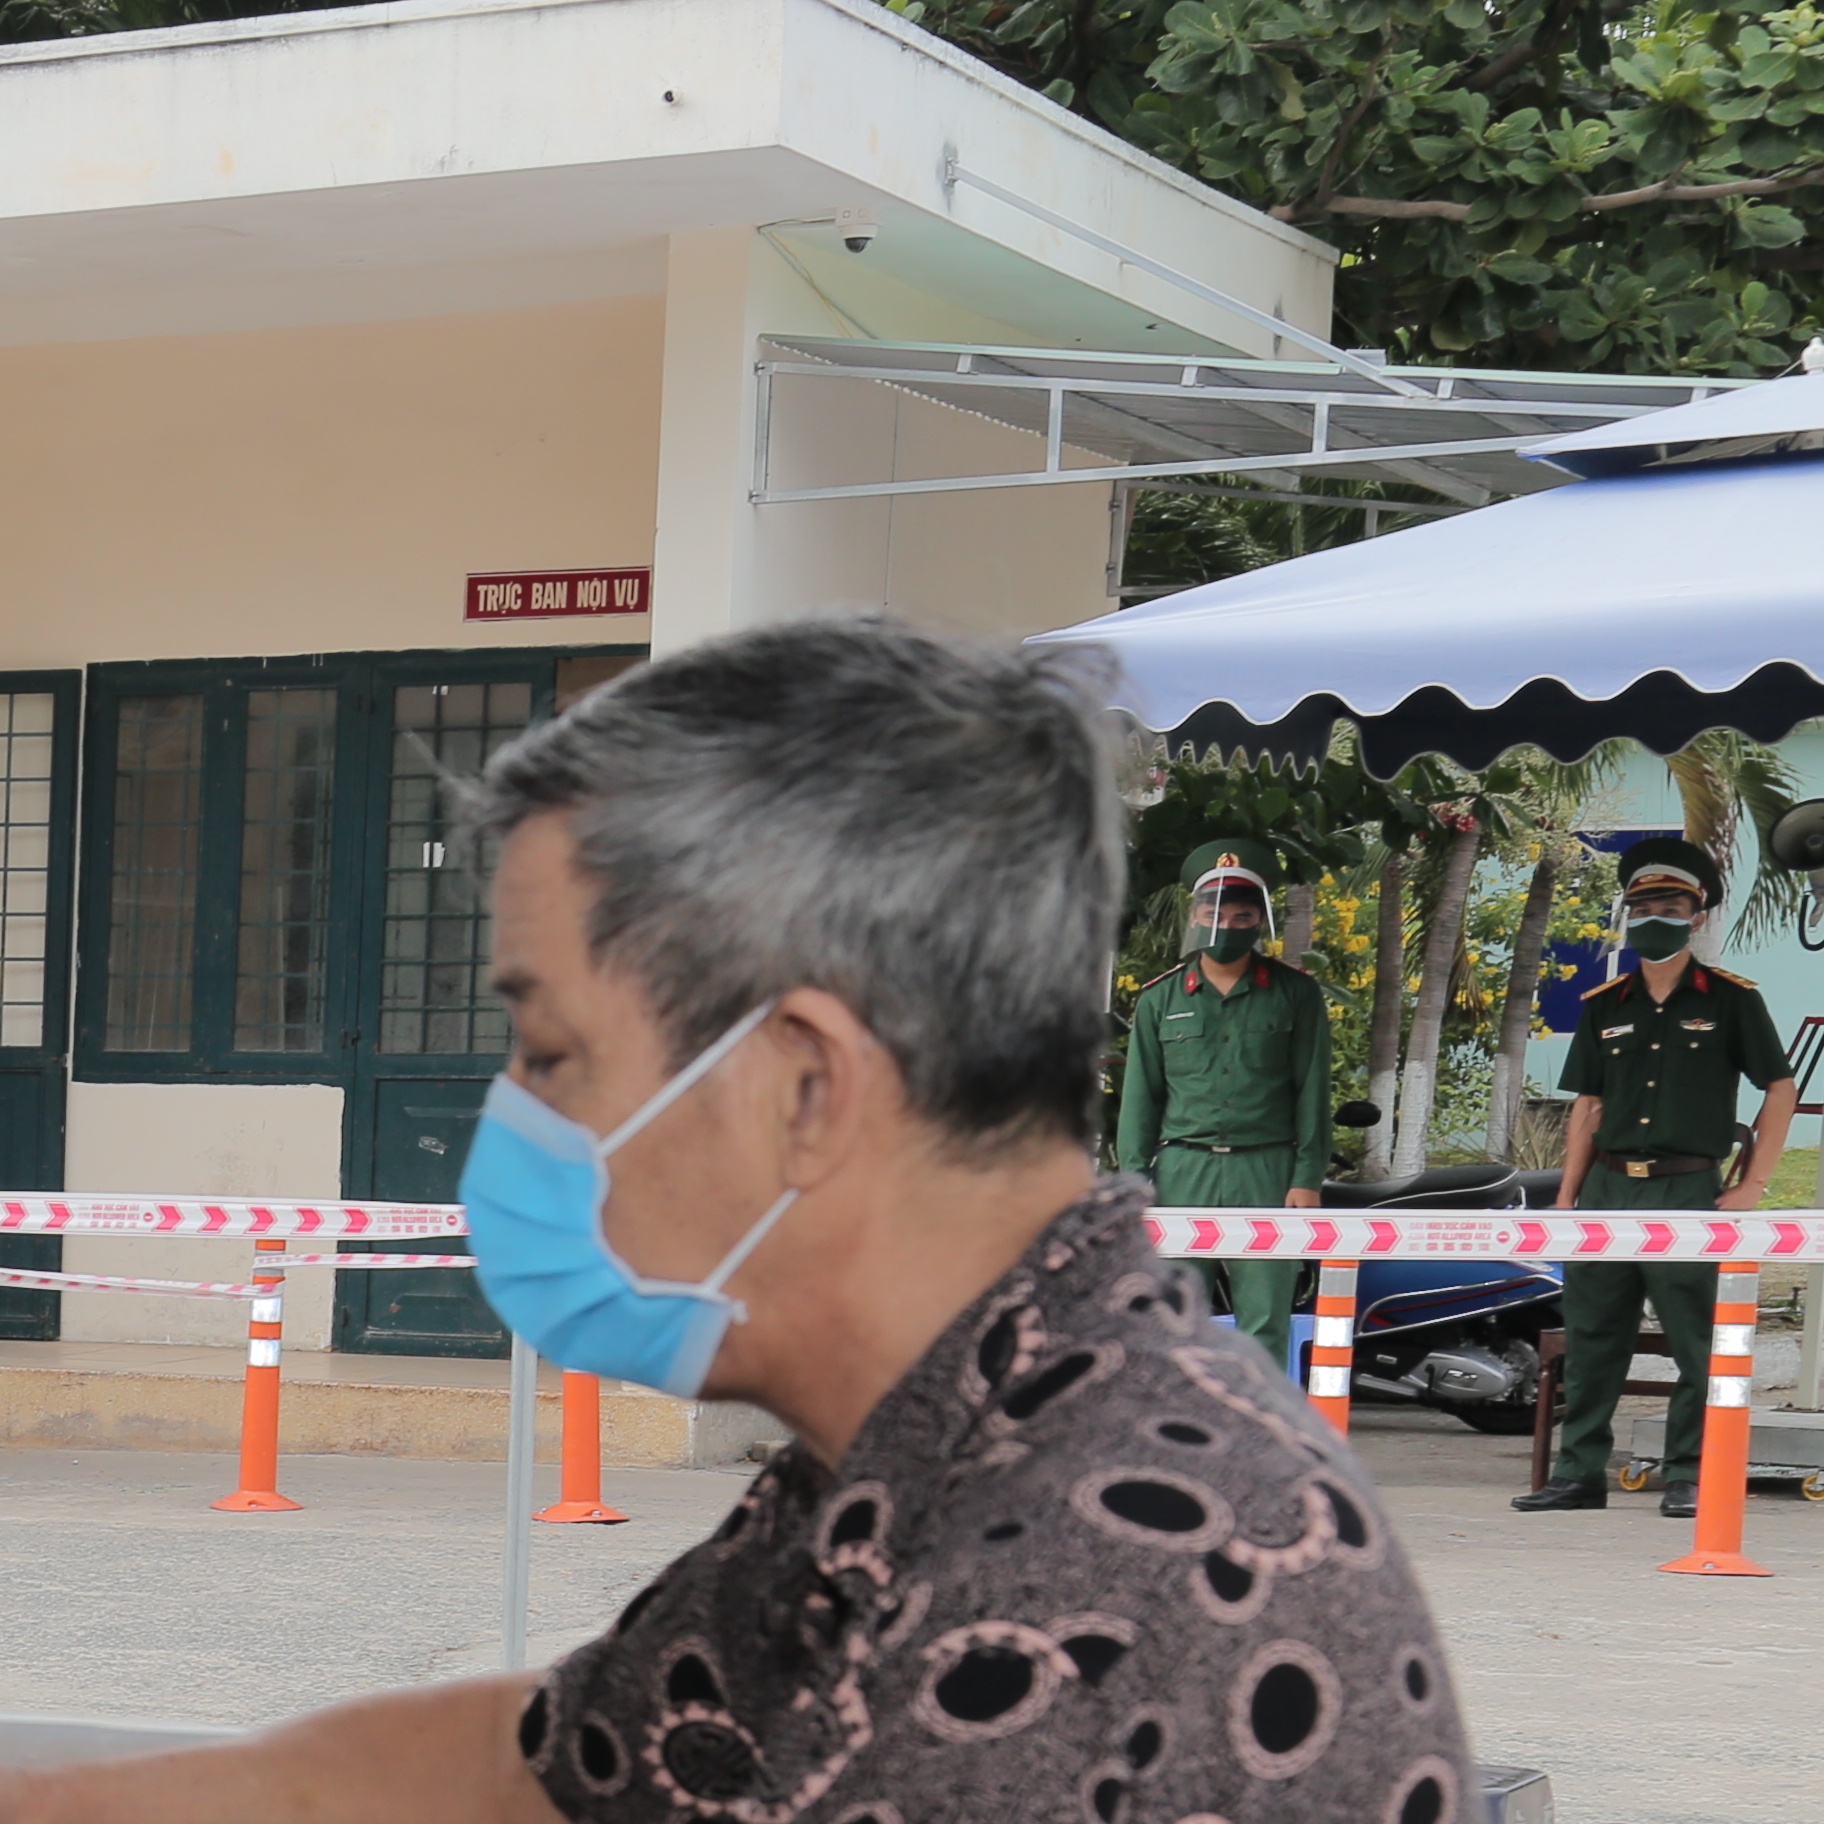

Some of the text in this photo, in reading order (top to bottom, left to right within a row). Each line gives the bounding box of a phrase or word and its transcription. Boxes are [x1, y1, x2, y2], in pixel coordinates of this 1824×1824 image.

[477, 577, 640, 614] TRỰC BAN NỘI VỤ
